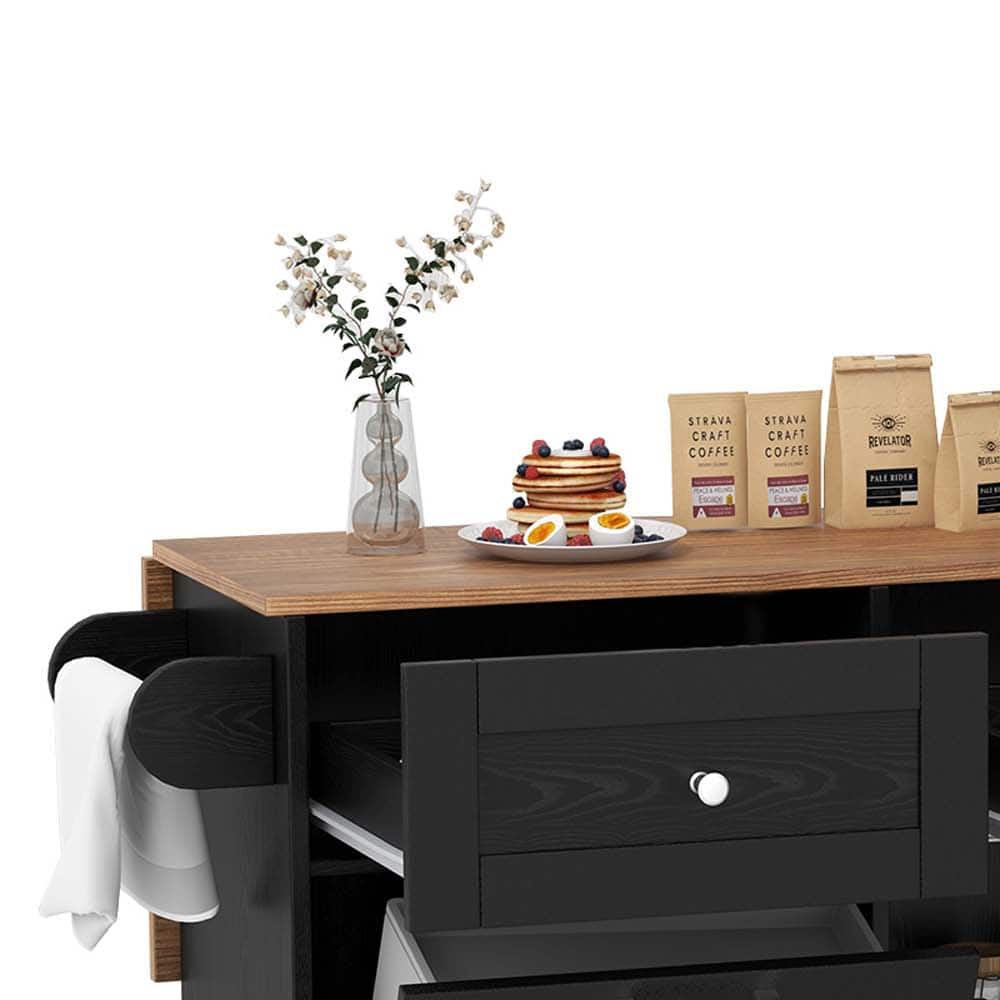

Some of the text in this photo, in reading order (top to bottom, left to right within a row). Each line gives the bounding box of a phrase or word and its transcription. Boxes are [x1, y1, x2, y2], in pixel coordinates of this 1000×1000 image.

[688, 416, 732, 426] STRAVA
[764, 415, 807, 425] STRAVA
[692, 431, 730, 441] CRAFT
[768, 429, 805, 441] CRAFT
[868, 435, 912, 449] REVELATOR
[688, 447, 735, 458] COFFEE
[764, 445, 809, 458] COFFEE
[870, 473, 914, 483] PALE RIDER
